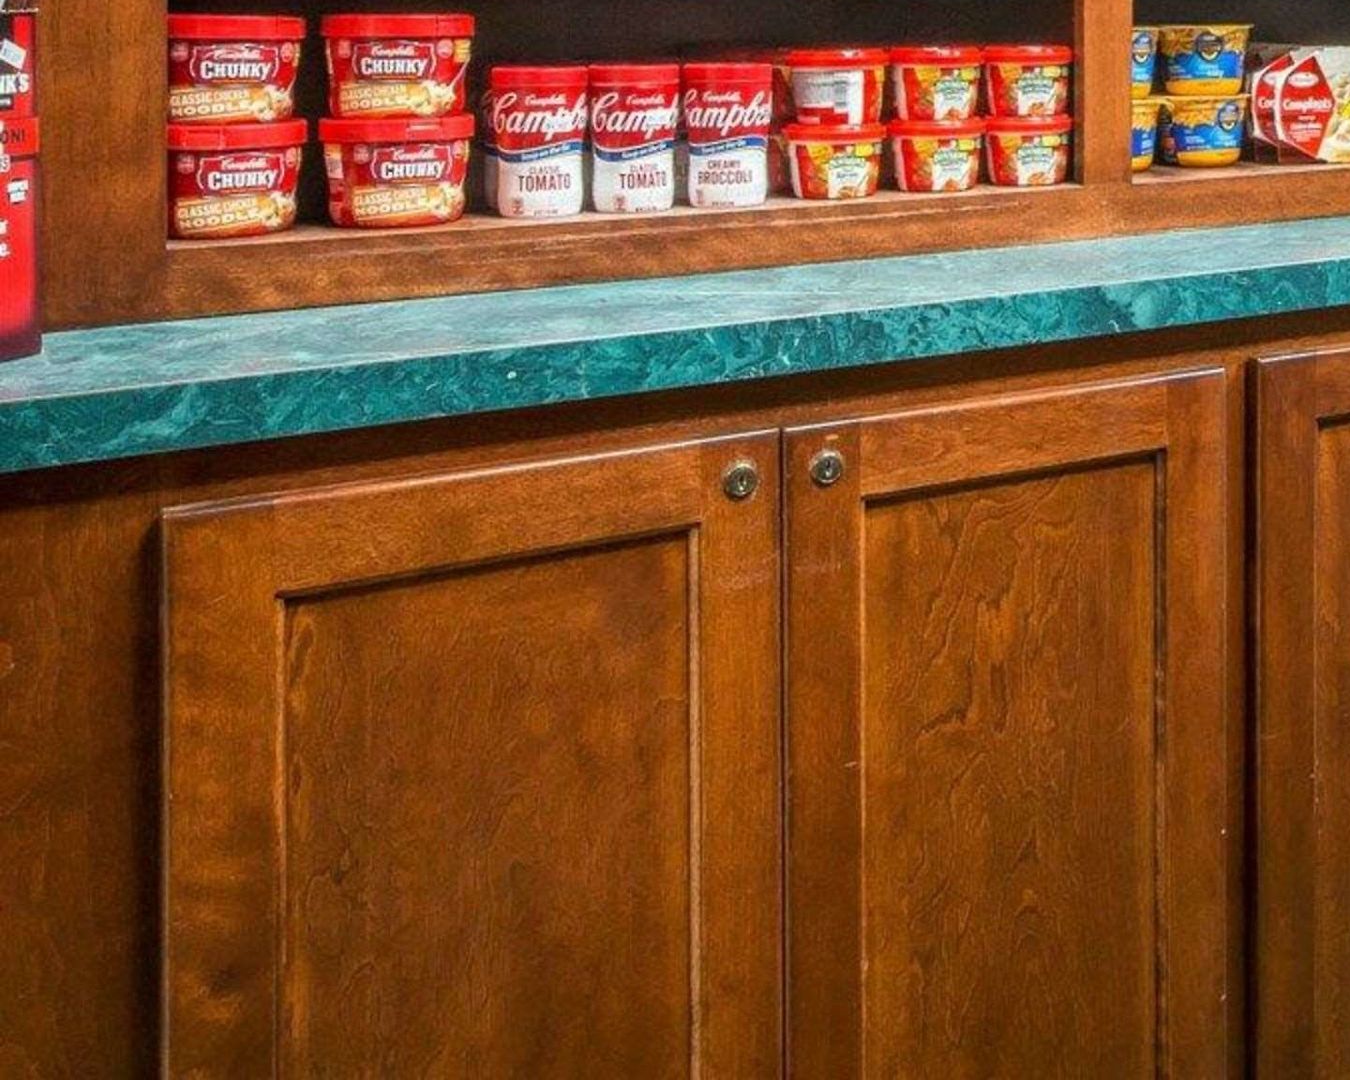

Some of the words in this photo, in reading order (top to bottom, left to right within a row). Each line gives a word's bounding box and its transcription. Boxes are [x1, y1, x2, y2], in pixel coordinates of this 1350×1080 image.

[200, 61, 272, 80] CHUNKY
[360, 58, 427, 77] CHUNKY
[207, 170, 277, 190] CHUNKY
[380, 161, 444, 180] CHUNKY
[698, 169, 753, 186] BROCCOLI
[519, 173, 571, 193] TOMATO
[620, 172, 667, 191] TOMATO
